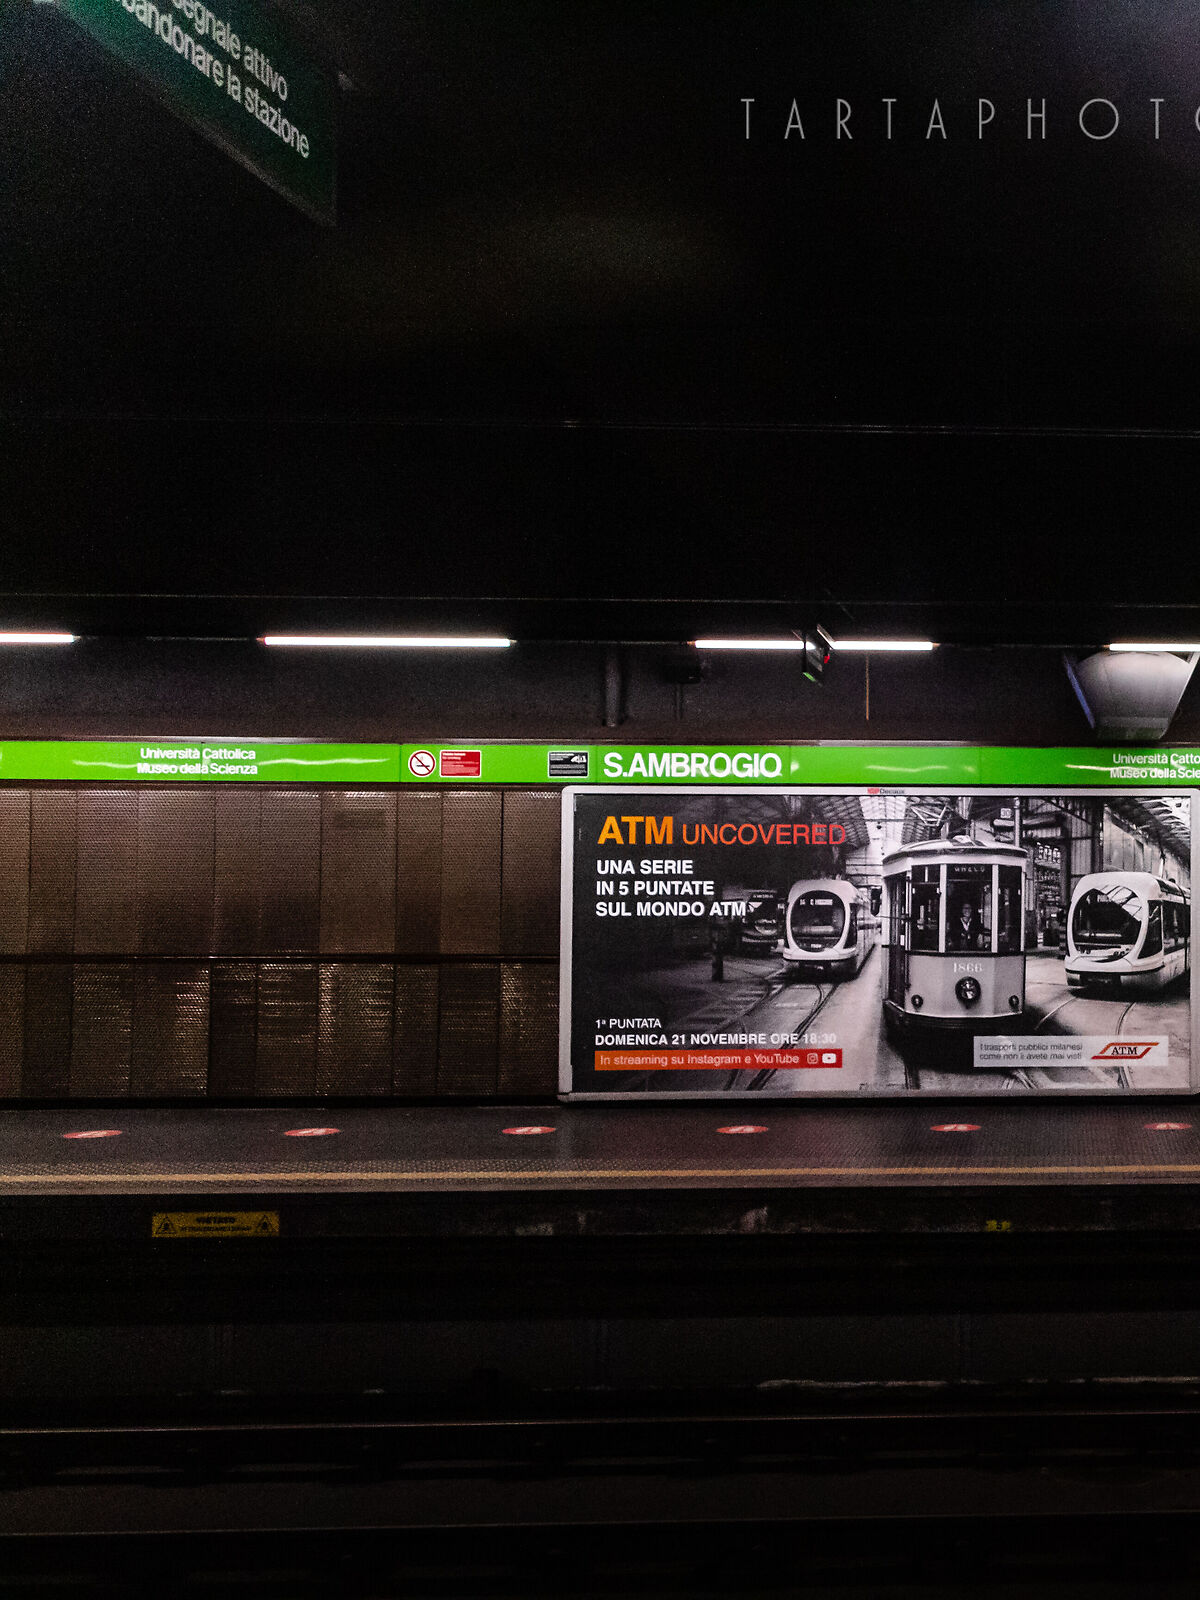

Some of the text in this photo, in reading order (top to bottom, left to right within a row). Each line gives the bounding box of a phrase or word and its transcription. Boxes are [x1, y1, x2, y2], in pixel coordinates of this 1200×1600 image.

[243, 45, 288, 101] attivo
[227, 64, 241, 104] la
[244, 86, 310, 159] stazione
[140, 748, 256, 760] Università Cattolica
[1112, 753, 1169, 764] Università
[137, 763, 258, 775] Museo della Scienza
[603, 752, 782, 778] S.AMBROGIO
[1110, 768, 1147, 779] Museo
[1149, 768, 1177, 779] della
[597, 815, 846, 845] ATM UNCOVERED
[596, 859, 694, 875] UNA SERIE
[596, 880, 714, 896] IN 5 PUNTATE
[595, 901, 747, 917] SUL MONDO ATM
[609, 1018, 662, 1029] PUNTATA
[594, 1033, 837, 1046] DOMENICA 21 NOVEMBRE ORE 18:30
[1018, 1043, 1049, 1052] pubblici
[1050, 1043, 1083, 1051] milanesi
[1111, 1046, 1138, 1055] ATM
[599, 1053, 800, 1068] In streaming su Instagram e YouTube
